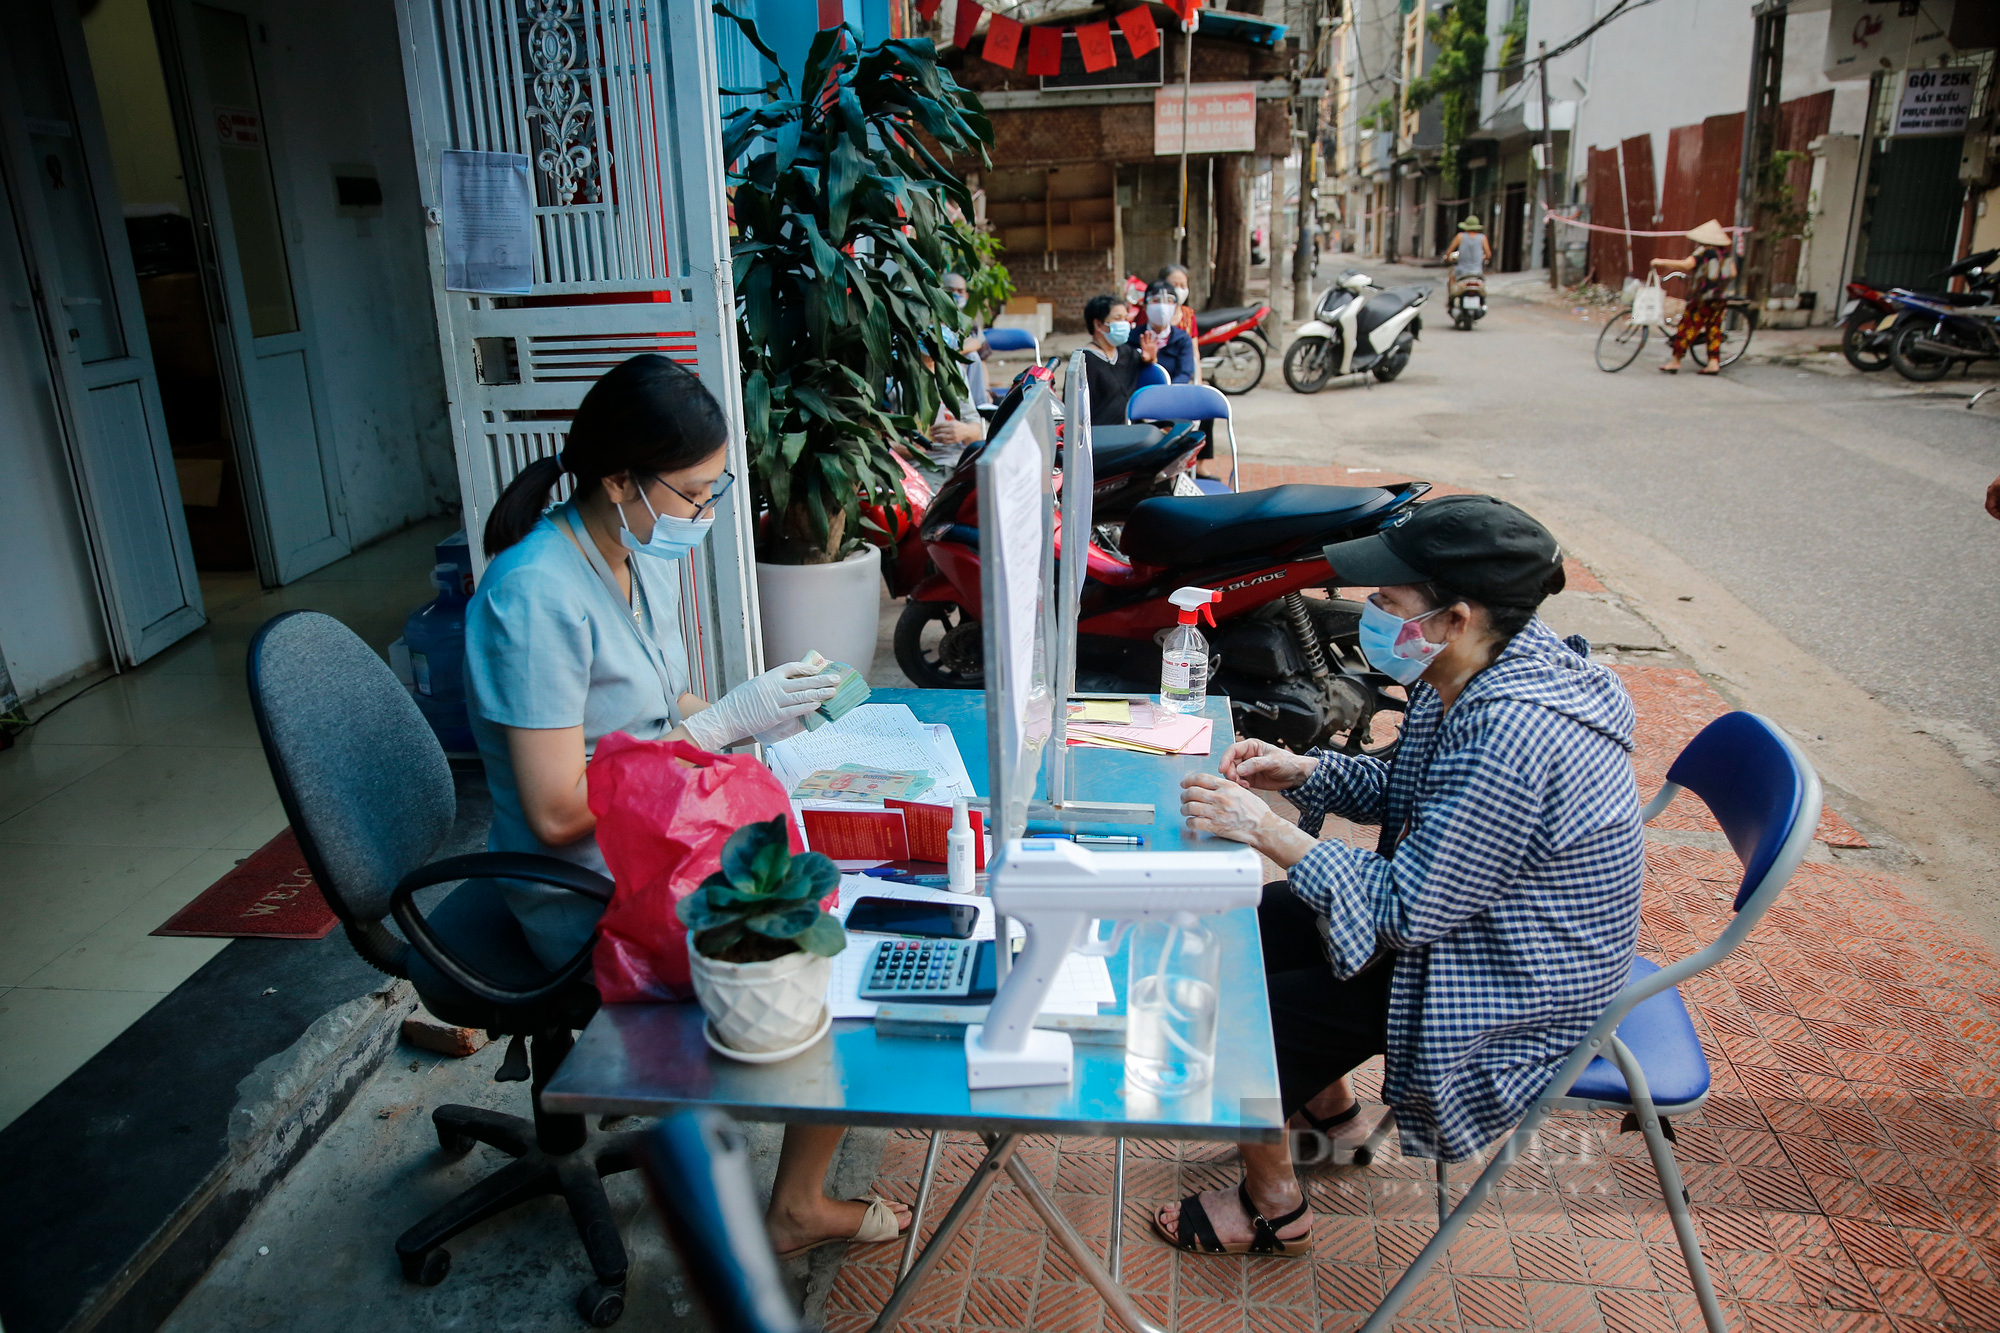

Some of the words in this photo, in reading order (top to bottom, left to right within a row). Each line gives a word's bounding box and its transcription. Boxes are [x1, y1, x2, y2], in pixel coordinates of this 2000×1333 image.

[1909, 72, 1937, 91] GỘI
[1940, 71, 1972, 87] 25K
[1228, 569, 1287, 591] BLADE
[239, 867, 313, 918] WELC
